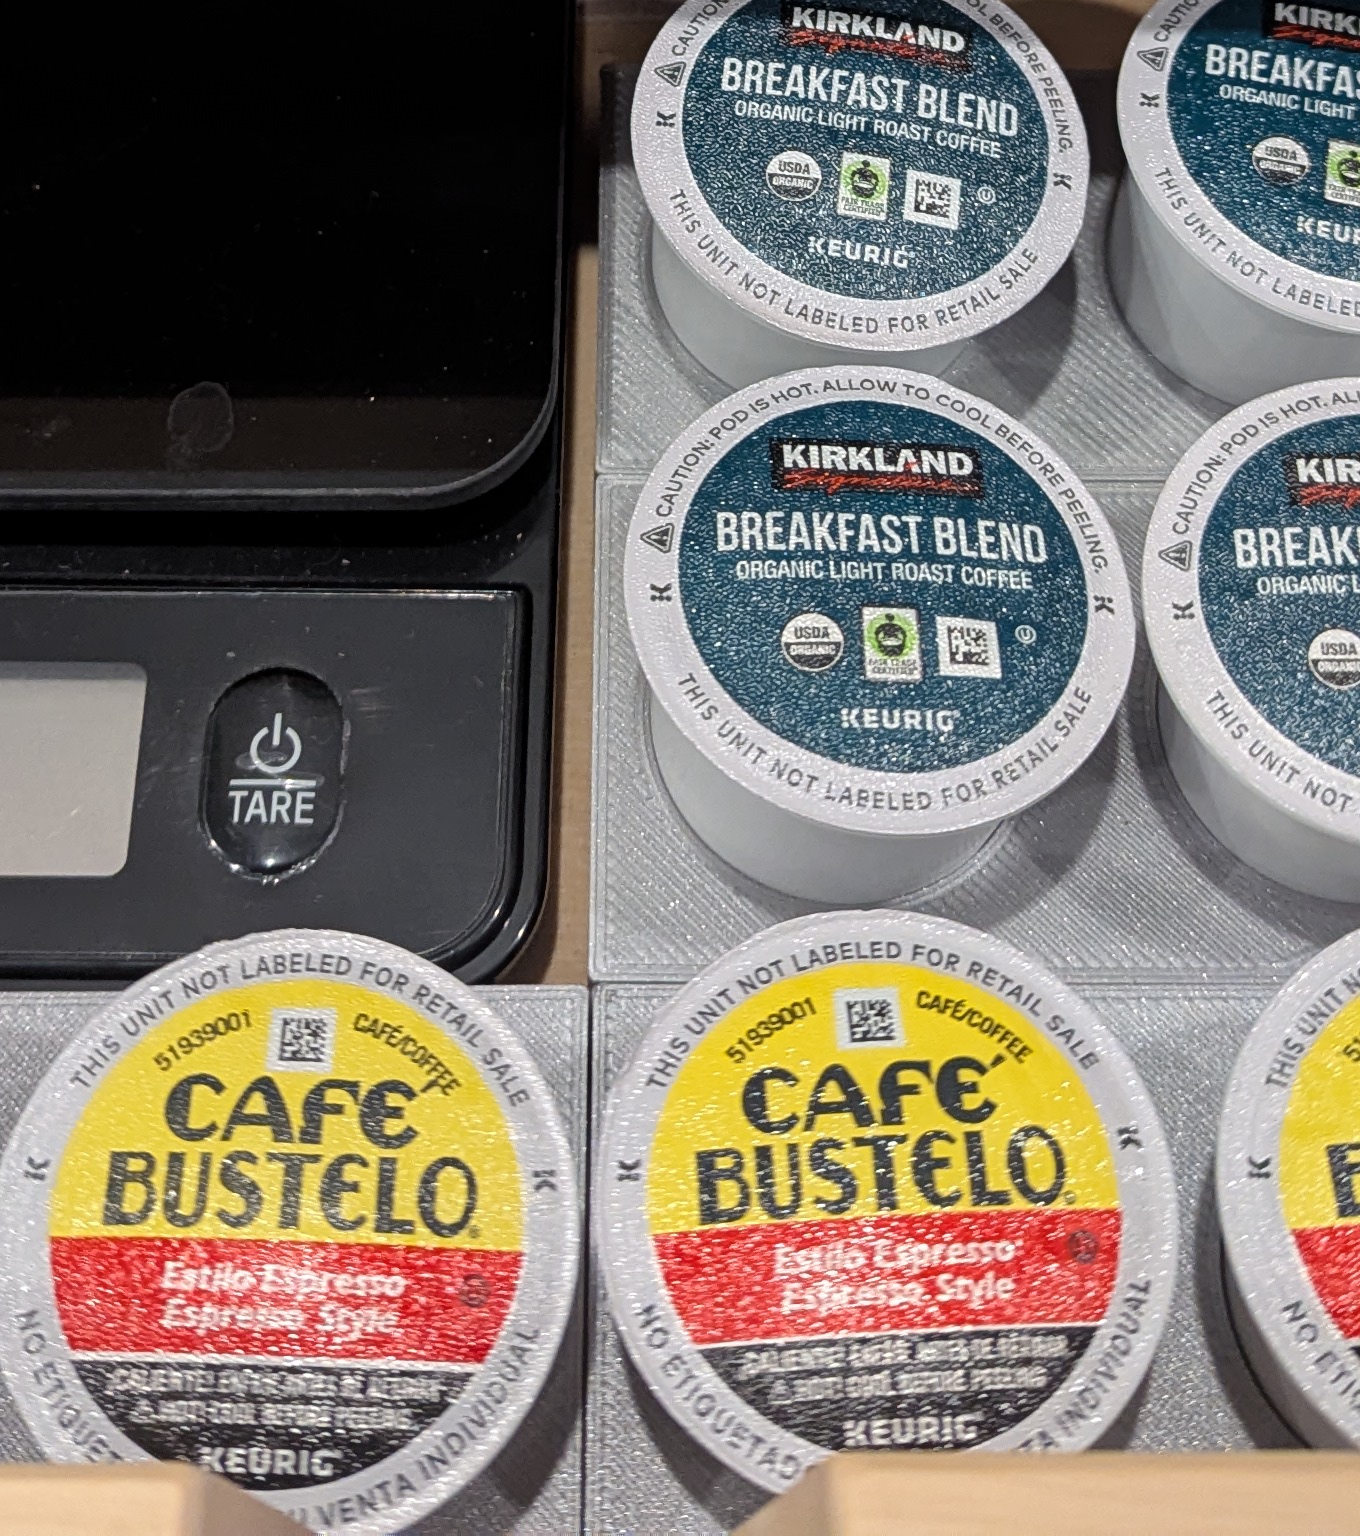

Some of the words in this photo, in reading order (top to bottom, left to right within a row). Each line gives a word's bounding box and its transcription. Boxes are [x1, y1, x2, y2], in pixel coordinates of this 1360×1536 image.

[791, 6, 966, 54] KIRKLAND
[722, 57, 909, 112] BREAKFAST
[918, 86, 1019, 137] BLEND
[1220, 85, 1300, 110] ORGANIC
[1304, 98, 1357, 120] LIGHT
[735, 100, 815, 124] ORGANIC
[819, 110, 868, 133] LIGHT
[873, 117, 932, 143] ROAST
[936, 129, 1002, 159] COFFEE
[772, 175, 813, 189] ORGANIC
[778, 161, 811, 175] USDA
[808, 235, 909, 268] KEURIG
[656, 438, 715, 518] CAUTION:
[710, 410, 749, 440] POD
[751, 398, 770, 414] IS
[771, 382, 820, 404] HOT.
[822, 378, 897, 394] ALLOW
[903, 383, 930, 400] TO
[935, 394, 992, 430] COOL
[995, 424, 1067, 477] BEFORE
[1059, 481, 1108, 574] PEELING.
[781, 445, 975, 476] KIRKLAND
[716, 511, 922, 556] BREAKFAST
[935, 516, 1047, 563] BLEND
[736, 561, 824, 580] ORGANIC
[828, 563, 885, 582] LIGHT
[891, 564, 954, 583] ROAST
[961, 566, 1033, 589] COFFEE
[1257, 575, 1347, 595] ORGANIC
[790, 643, 836, 656] ORGANIC
[794, 626, 830, 640] USDA
[1321, 642, 1358, 656] USDA
[841, 708, 954, 731] KEURIG
[677, 673, 718, 721] THIS
[717, 720, 762, 757] UNIT
[770, 761, 818, 794] NOT
[825, 782, 932, 811] LABELED
[941, 779, 986, 805] FOR
[992, 740, 1058, 788] RETAIL
[1056, 687, 1093, 736] SALE
[1206, 689, 1245, 740] THIS
[1248, 740, 1300, 782] UNIT
[1304, 780, 1352, 813] NOT
[228, 790, 316, 825] TARE
[69, 1036, 122, 1089] THIS
[120, 990, 177, 1039] UNIT
[181, 965, 233, 998] NOT
[239, 952, 352, 980] LABELED
[360, 960, 411, 988] FOR
[410, 985, 483, 1049] RETAIL
[482, 1046, 533, 1108] SALE
[695, 1125, 1067, 1226] BUSTELO
[102, 1150, 478, 1239] BUSTELO
[774, 1243, 862, 1274] Estilo
[873, 1237, 1018, 1273] Espresso
[160, 1261, 254, 1296] Estilo
[261, 1264, 408, 1300] Espresso
[780, 1280, 926, 1312] Espresso
[936, 1274, 1014, 1306] Style
[161, 1300, 305, 1333] Espresso
[316, 1303, 400, 1343] Style
[842, 1416, 980, 1447] KEURIG
[199, 1446, 336, 1478] KEURIG
[313, 1473, 416, 1530] VENTA
